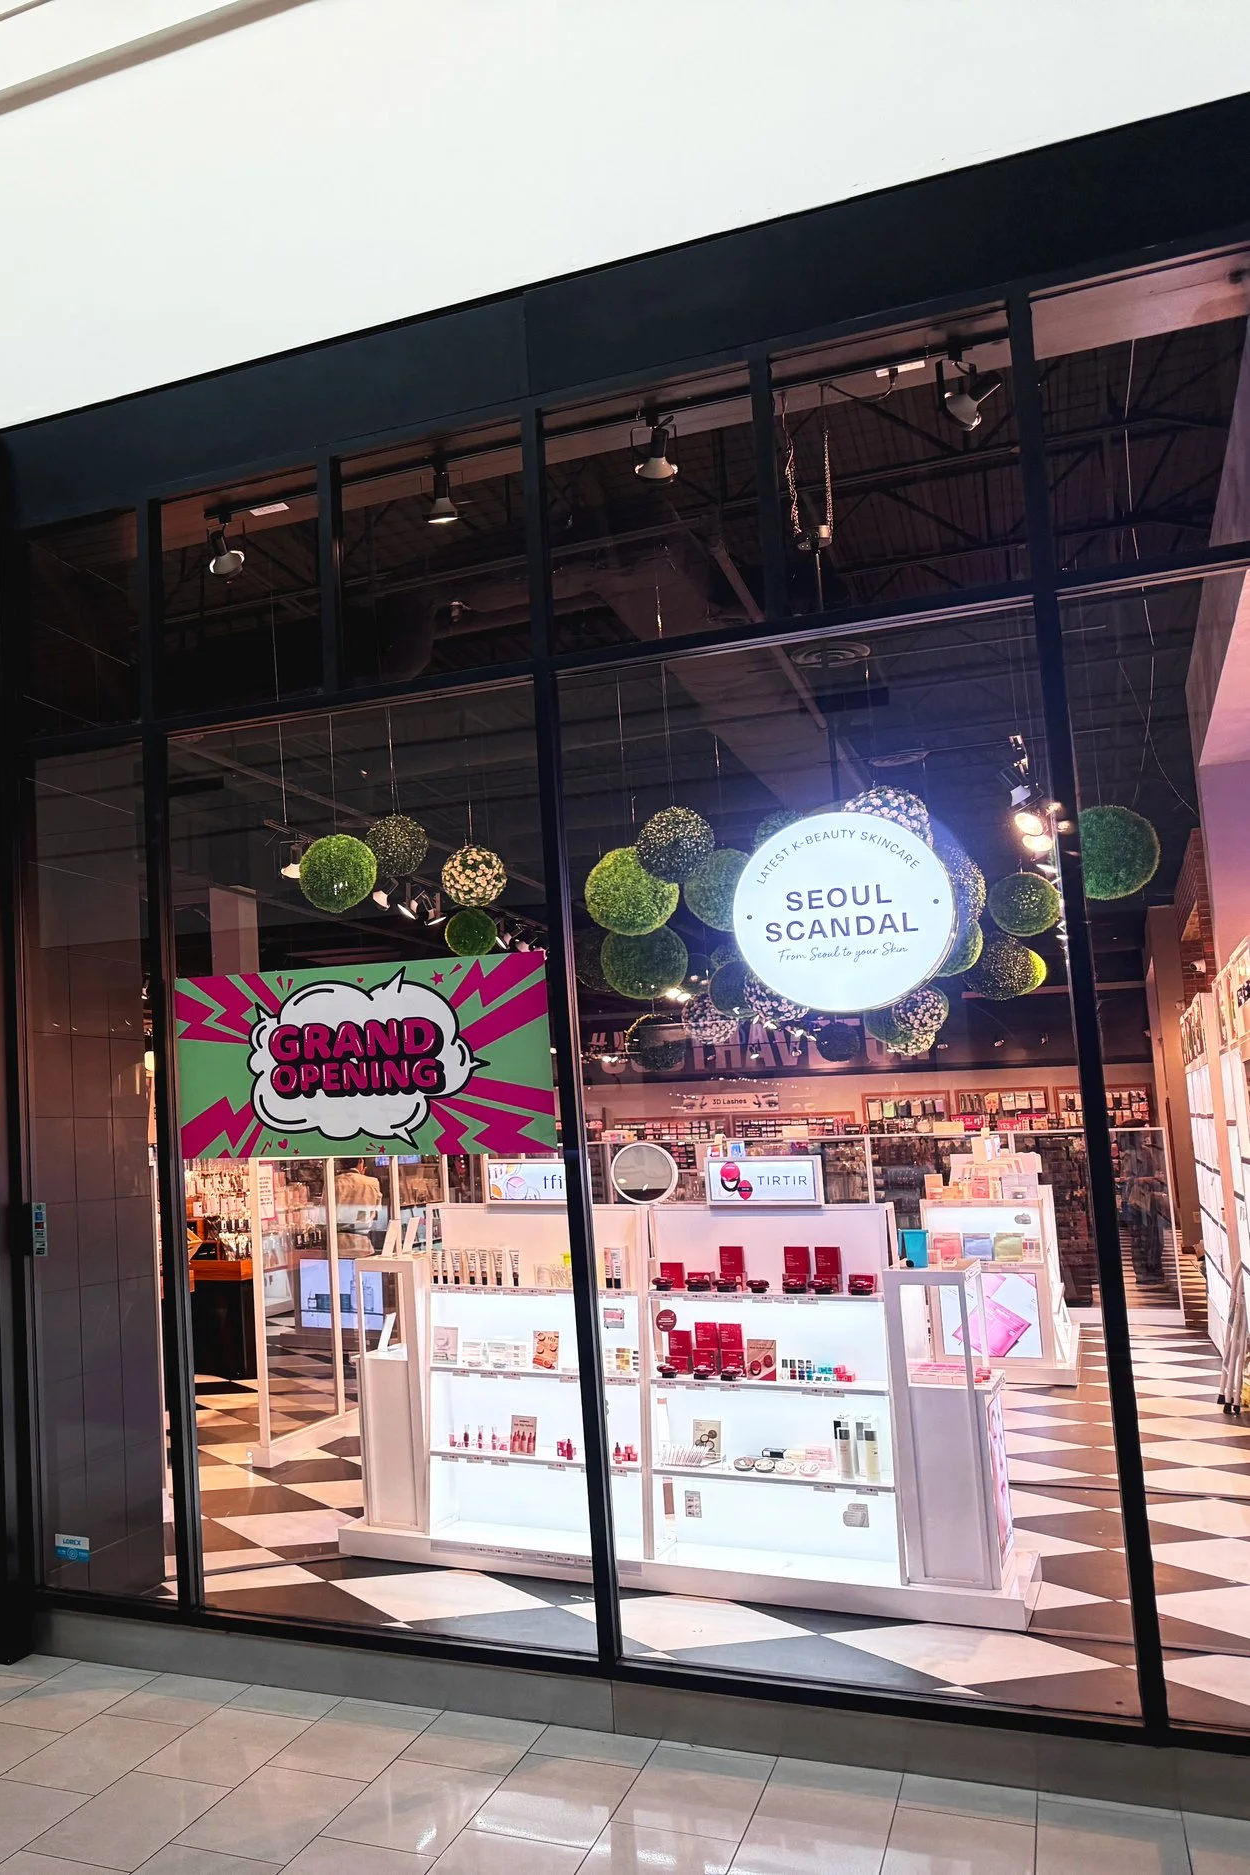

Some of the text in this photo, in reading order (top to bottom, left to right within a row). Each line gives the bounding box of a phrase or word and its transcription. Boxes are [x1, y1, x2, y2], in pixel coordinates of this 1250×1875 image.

[756, 829, 920, 885] LATEST K-BEAUTY SKINCARE
[786, 884, 892, 912] SEOUL
[765, 912, 919, 942] SCANDAL
[778, 941, 908, 963] From Seoul to your Skin
[269, 1017, 439, 1062] GRAND
[270, 1058, 441, 1096] OPENING
[757, 1175, 808, 1186] TIRTIR
